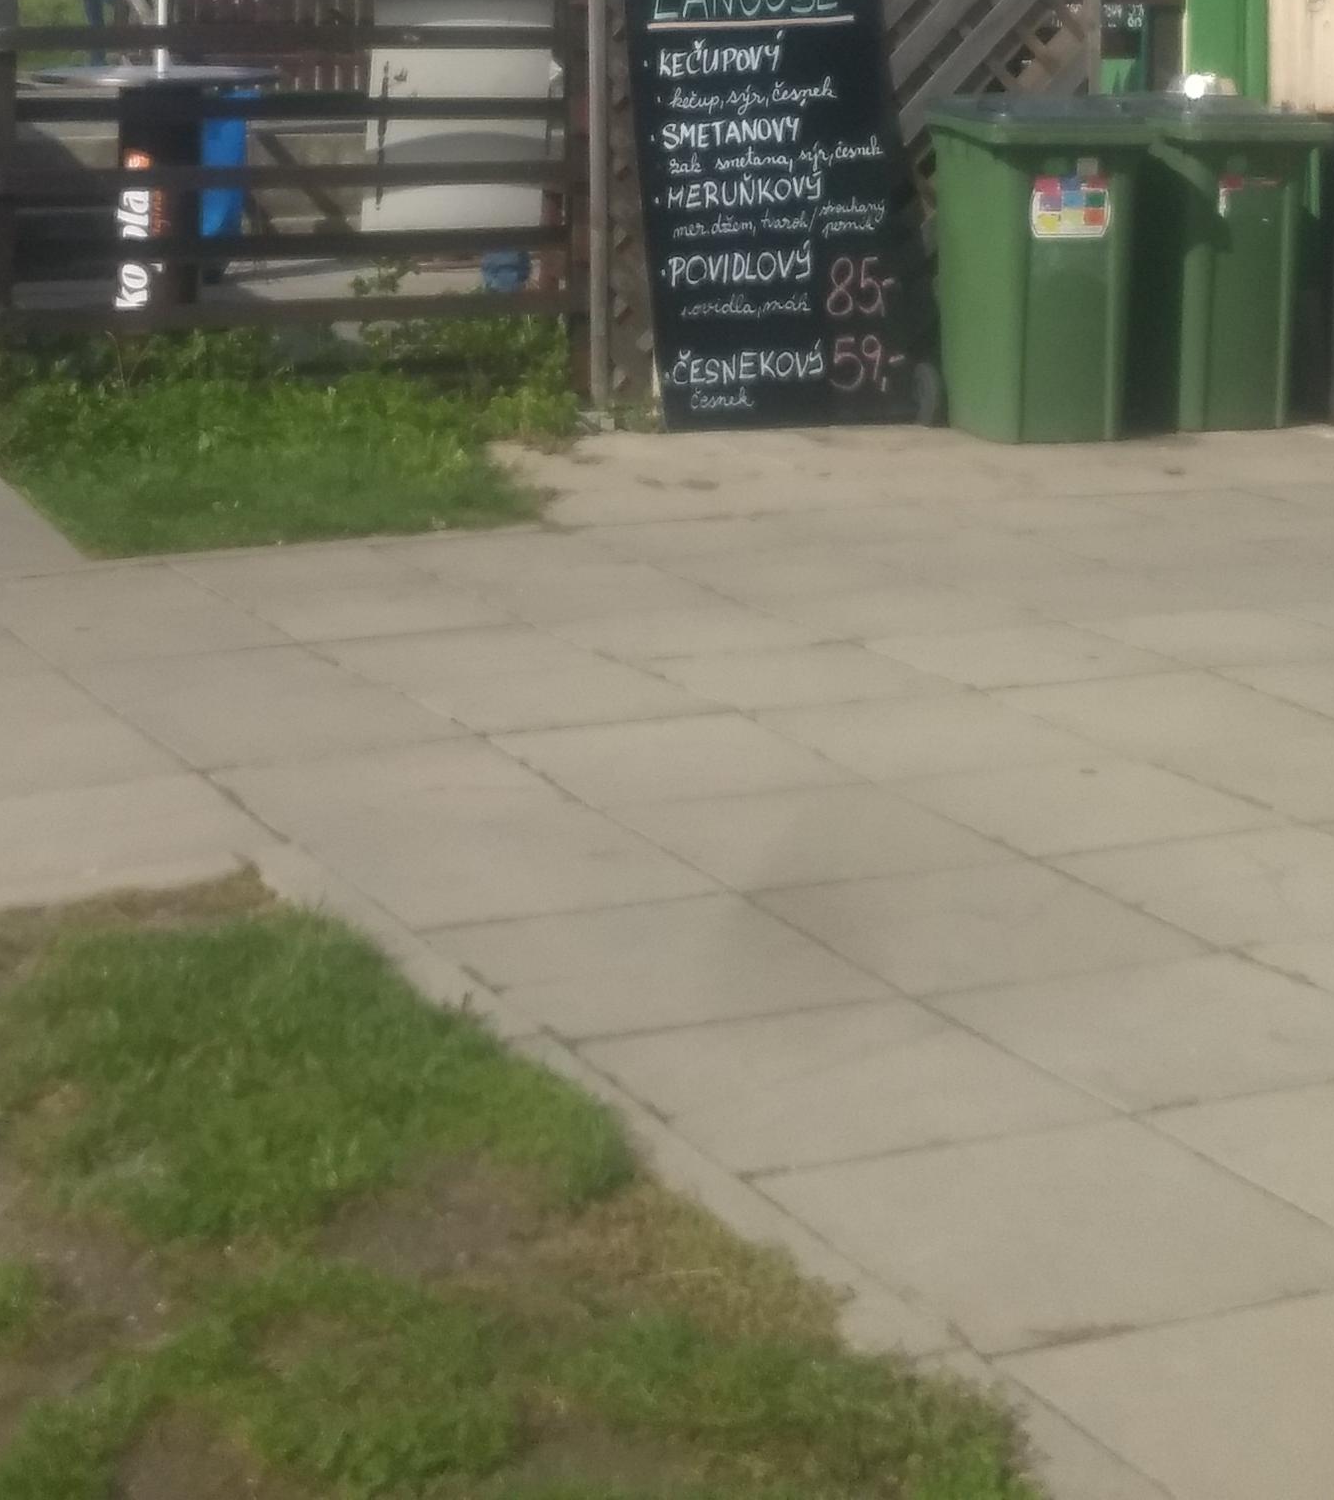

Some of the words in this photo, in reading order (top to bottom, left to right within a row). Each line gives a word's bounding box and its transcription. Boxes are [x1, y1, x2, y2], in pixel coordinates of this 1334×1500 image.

[658, 30, 784, 78] KEČUPOVÝ
[667, 171, 823, 210] MERUŇKOVÝ
[669, 238, 812, 287] POVIDLOVÝ
[671, 338, 825, 387] ČESNEKOVÝ
